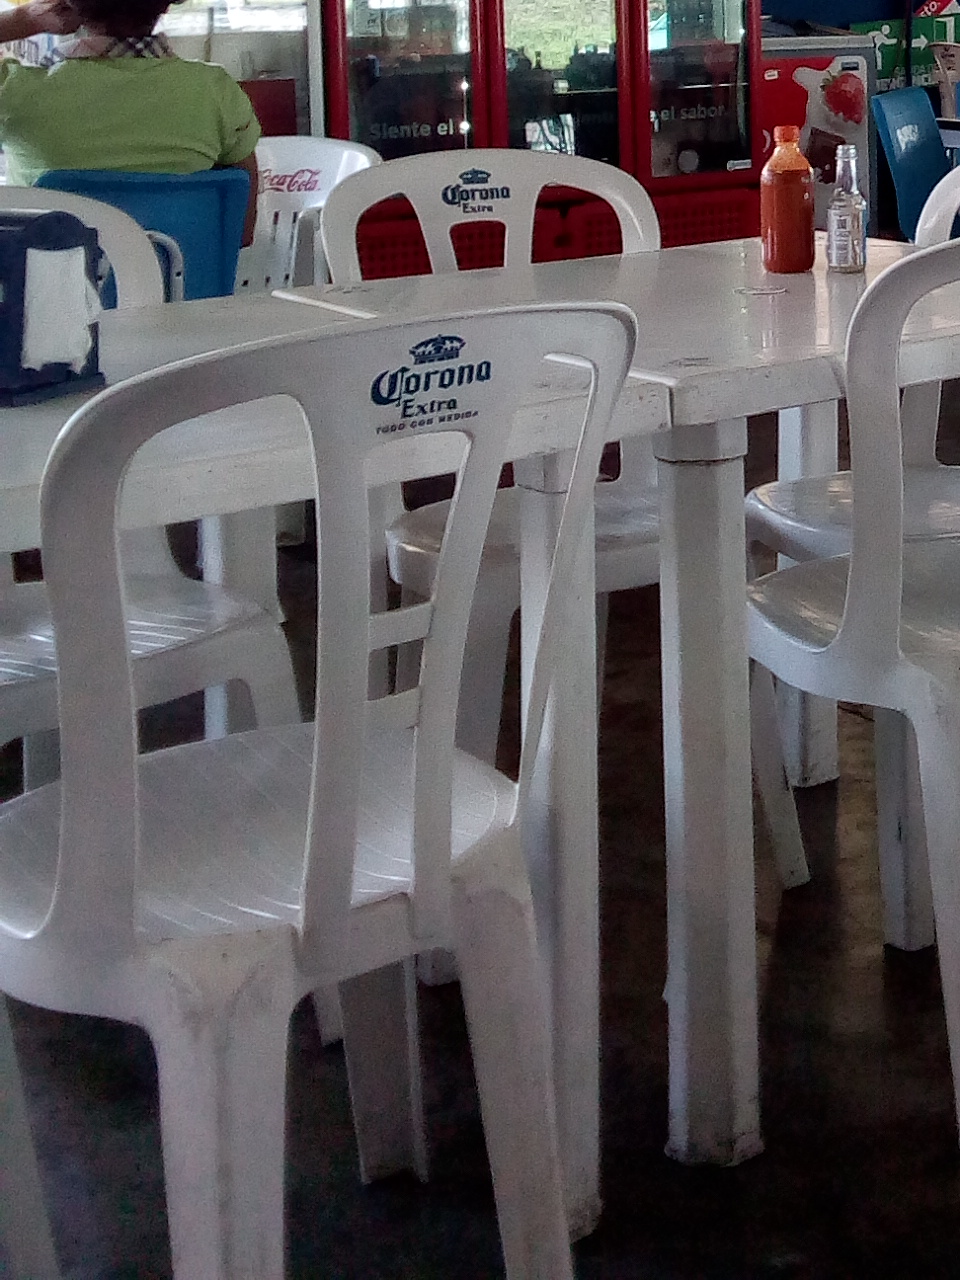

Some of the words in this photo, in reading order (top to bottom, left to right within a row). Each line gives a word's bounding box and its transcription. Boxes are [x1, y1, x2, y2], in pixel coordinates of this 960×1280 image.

[436, 118, 454, 136] el
[441, 183, 511, 208] Corona
[462, 201, 494, 214] Extra
[370, 360, 492, 408] Corona
[400, 398, 458, 419] Extra
[375, 422, 406, 435] TODO
